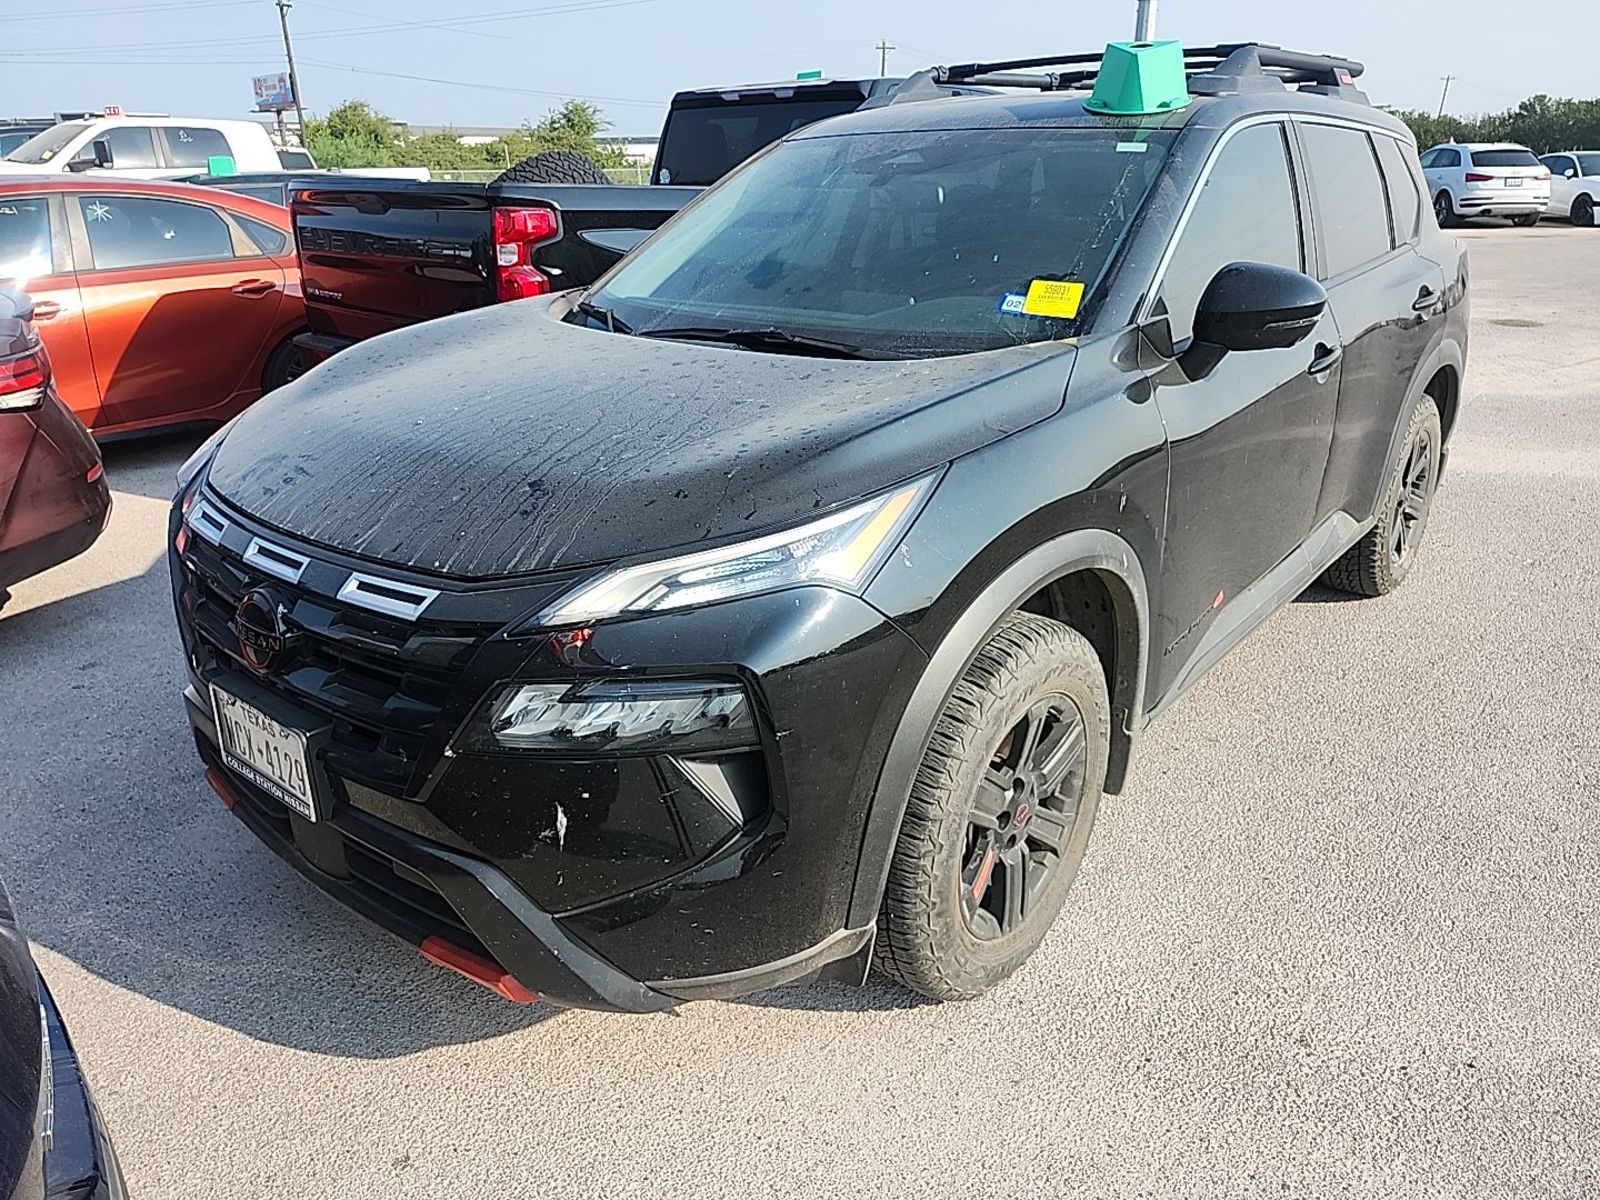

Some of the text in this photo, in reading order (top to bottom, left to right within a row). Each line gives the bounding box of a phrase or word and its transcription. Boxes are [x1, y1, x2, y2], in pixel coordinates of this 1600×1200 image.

[1006, 299, 1022, 308] 02
[240, 705, 277, 738] TEXAS
[227, 756, 311, 818] COLLEGE STATION NISSAN
